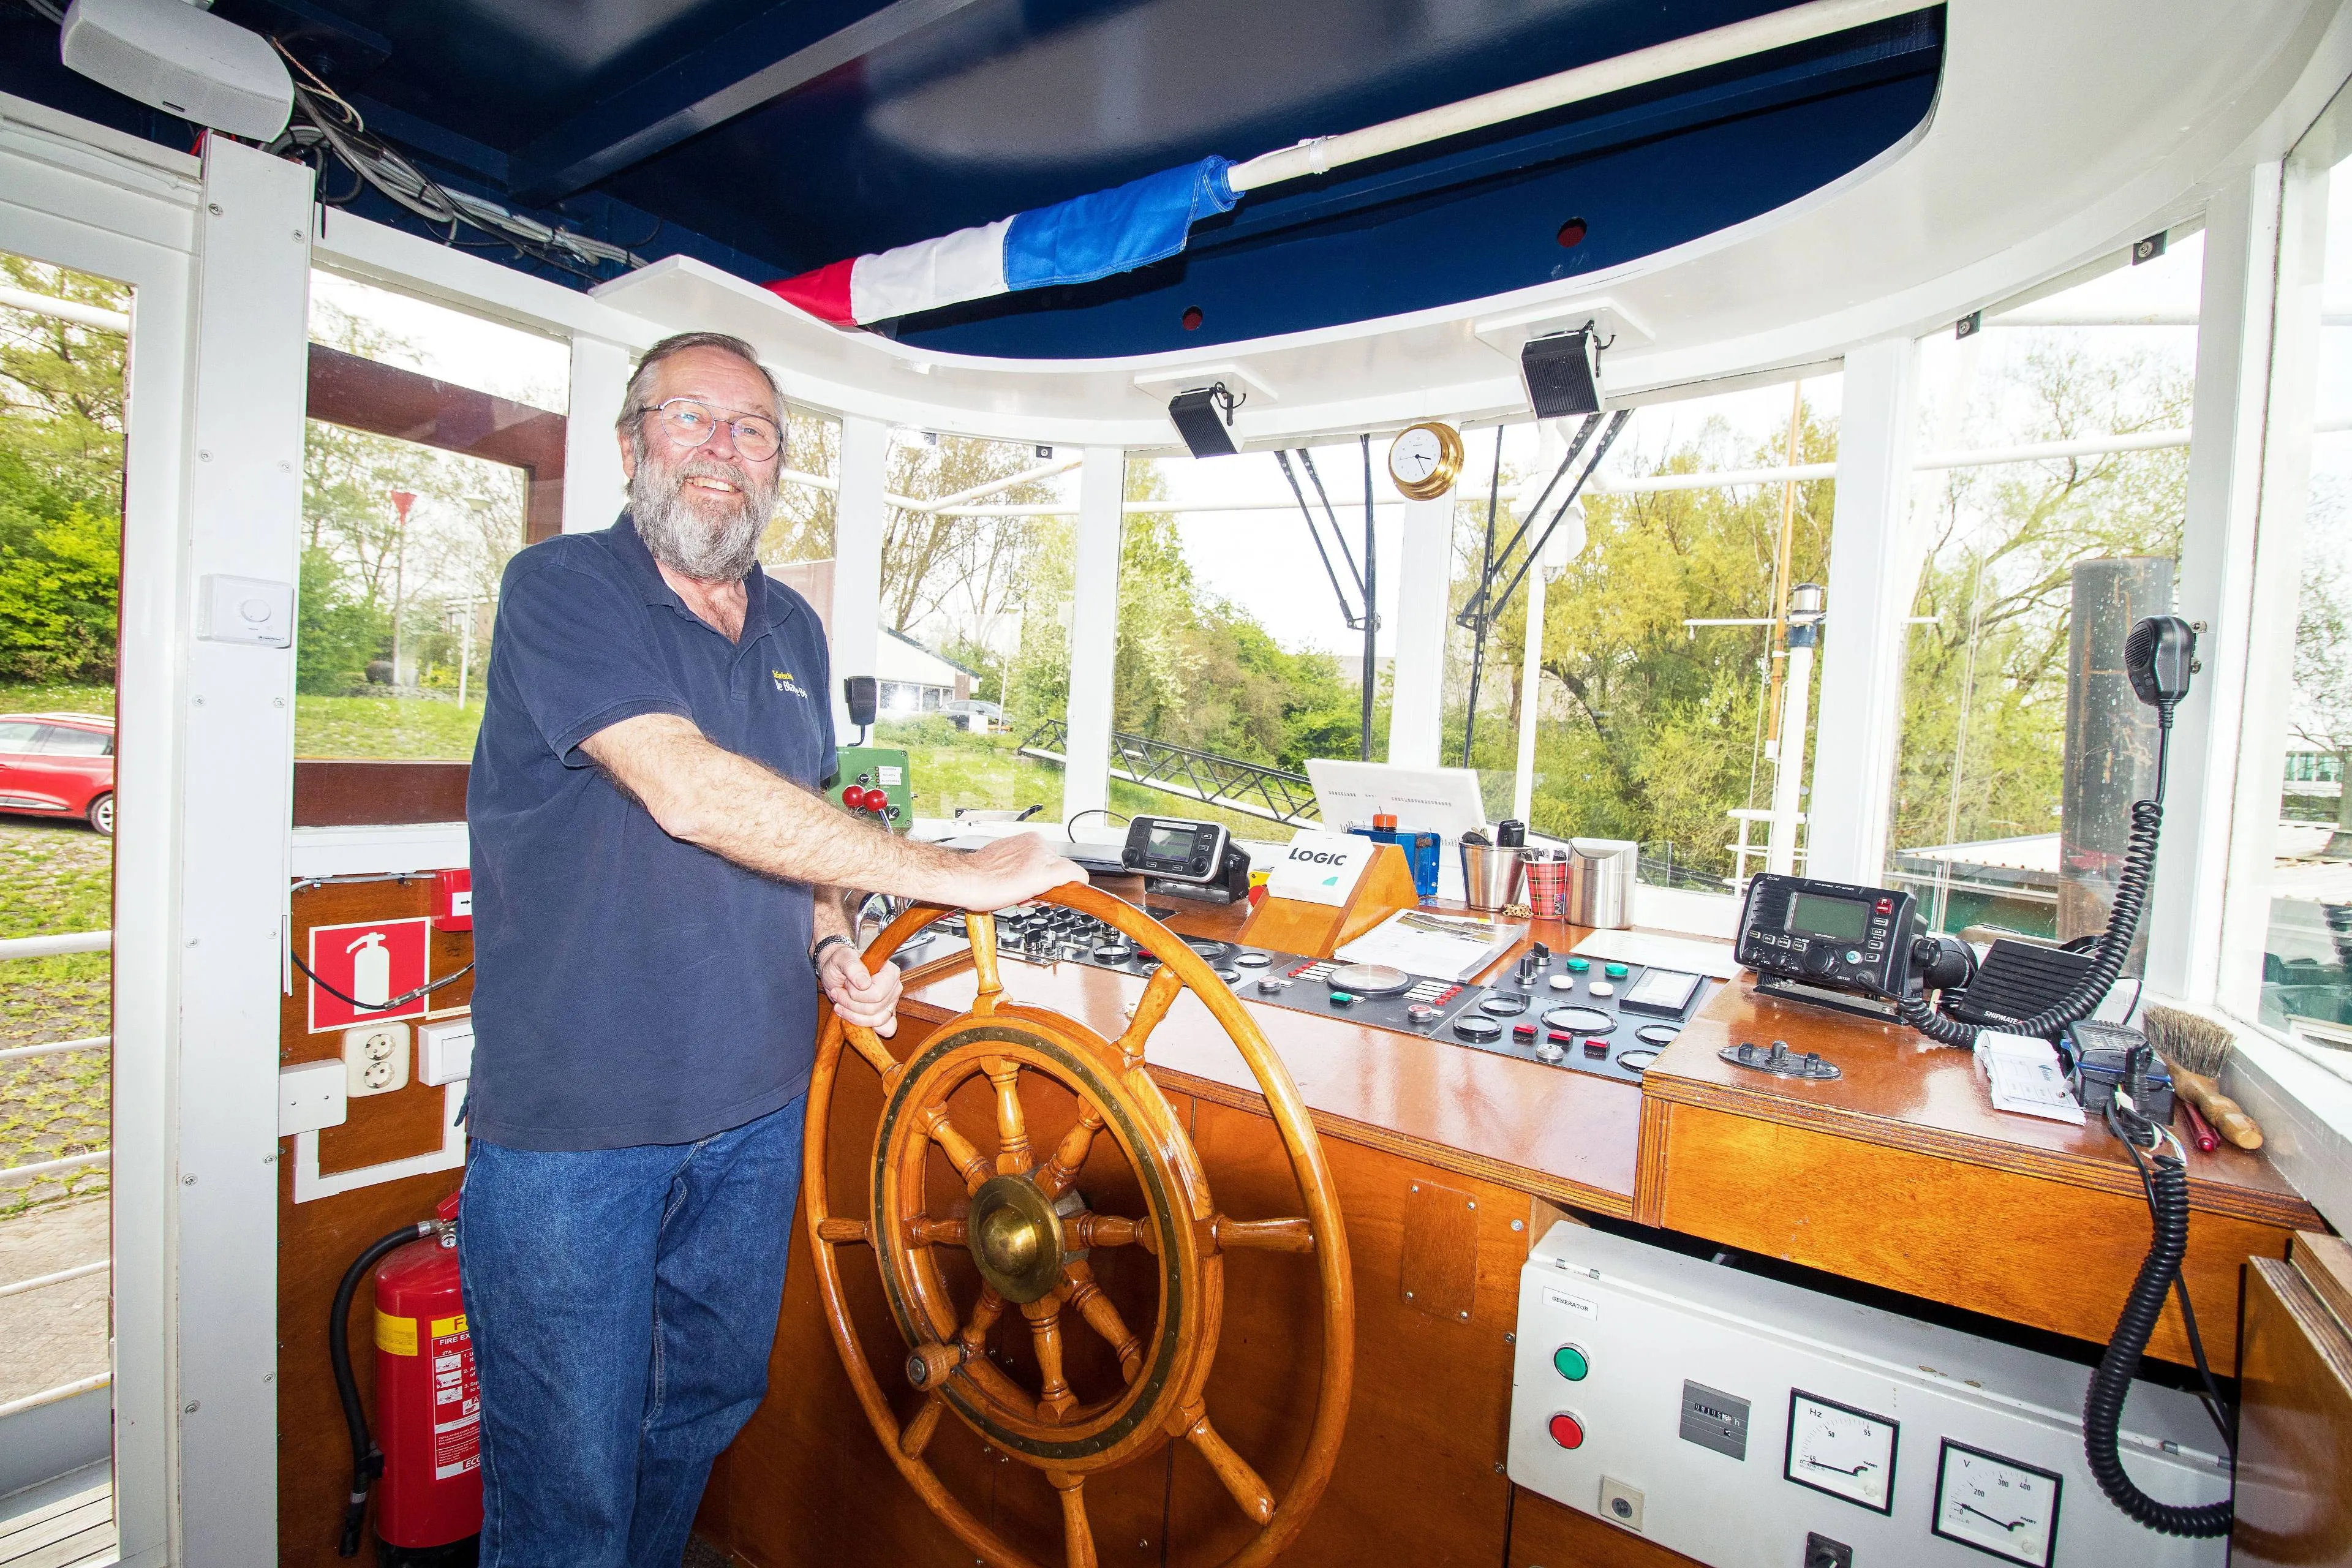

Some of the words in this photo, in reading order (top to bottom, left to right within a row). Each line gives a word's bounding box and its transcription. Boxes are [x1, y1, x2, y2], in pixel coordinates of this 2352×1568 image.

[1288, 847, 1348, 866] LOGIC
[1984, 1010, 2019, 1025] SHIPMATE
[1551, 1295, 1589, 1312] GENERATOR
[454, 1316, 468, 1330] F
[439, 1336, 458, 1346] FIRE
[1809, 1408, 1822, 1418] Hz
[1863, 1428, 1871, 1437] 55
[1964, 1459, 1970, 1468] V
[1997, 1479, 2010, 1488] 300
[2019, 1482, 2031, 1491] 400
[1973, 1488, 1985, 1498] 200
